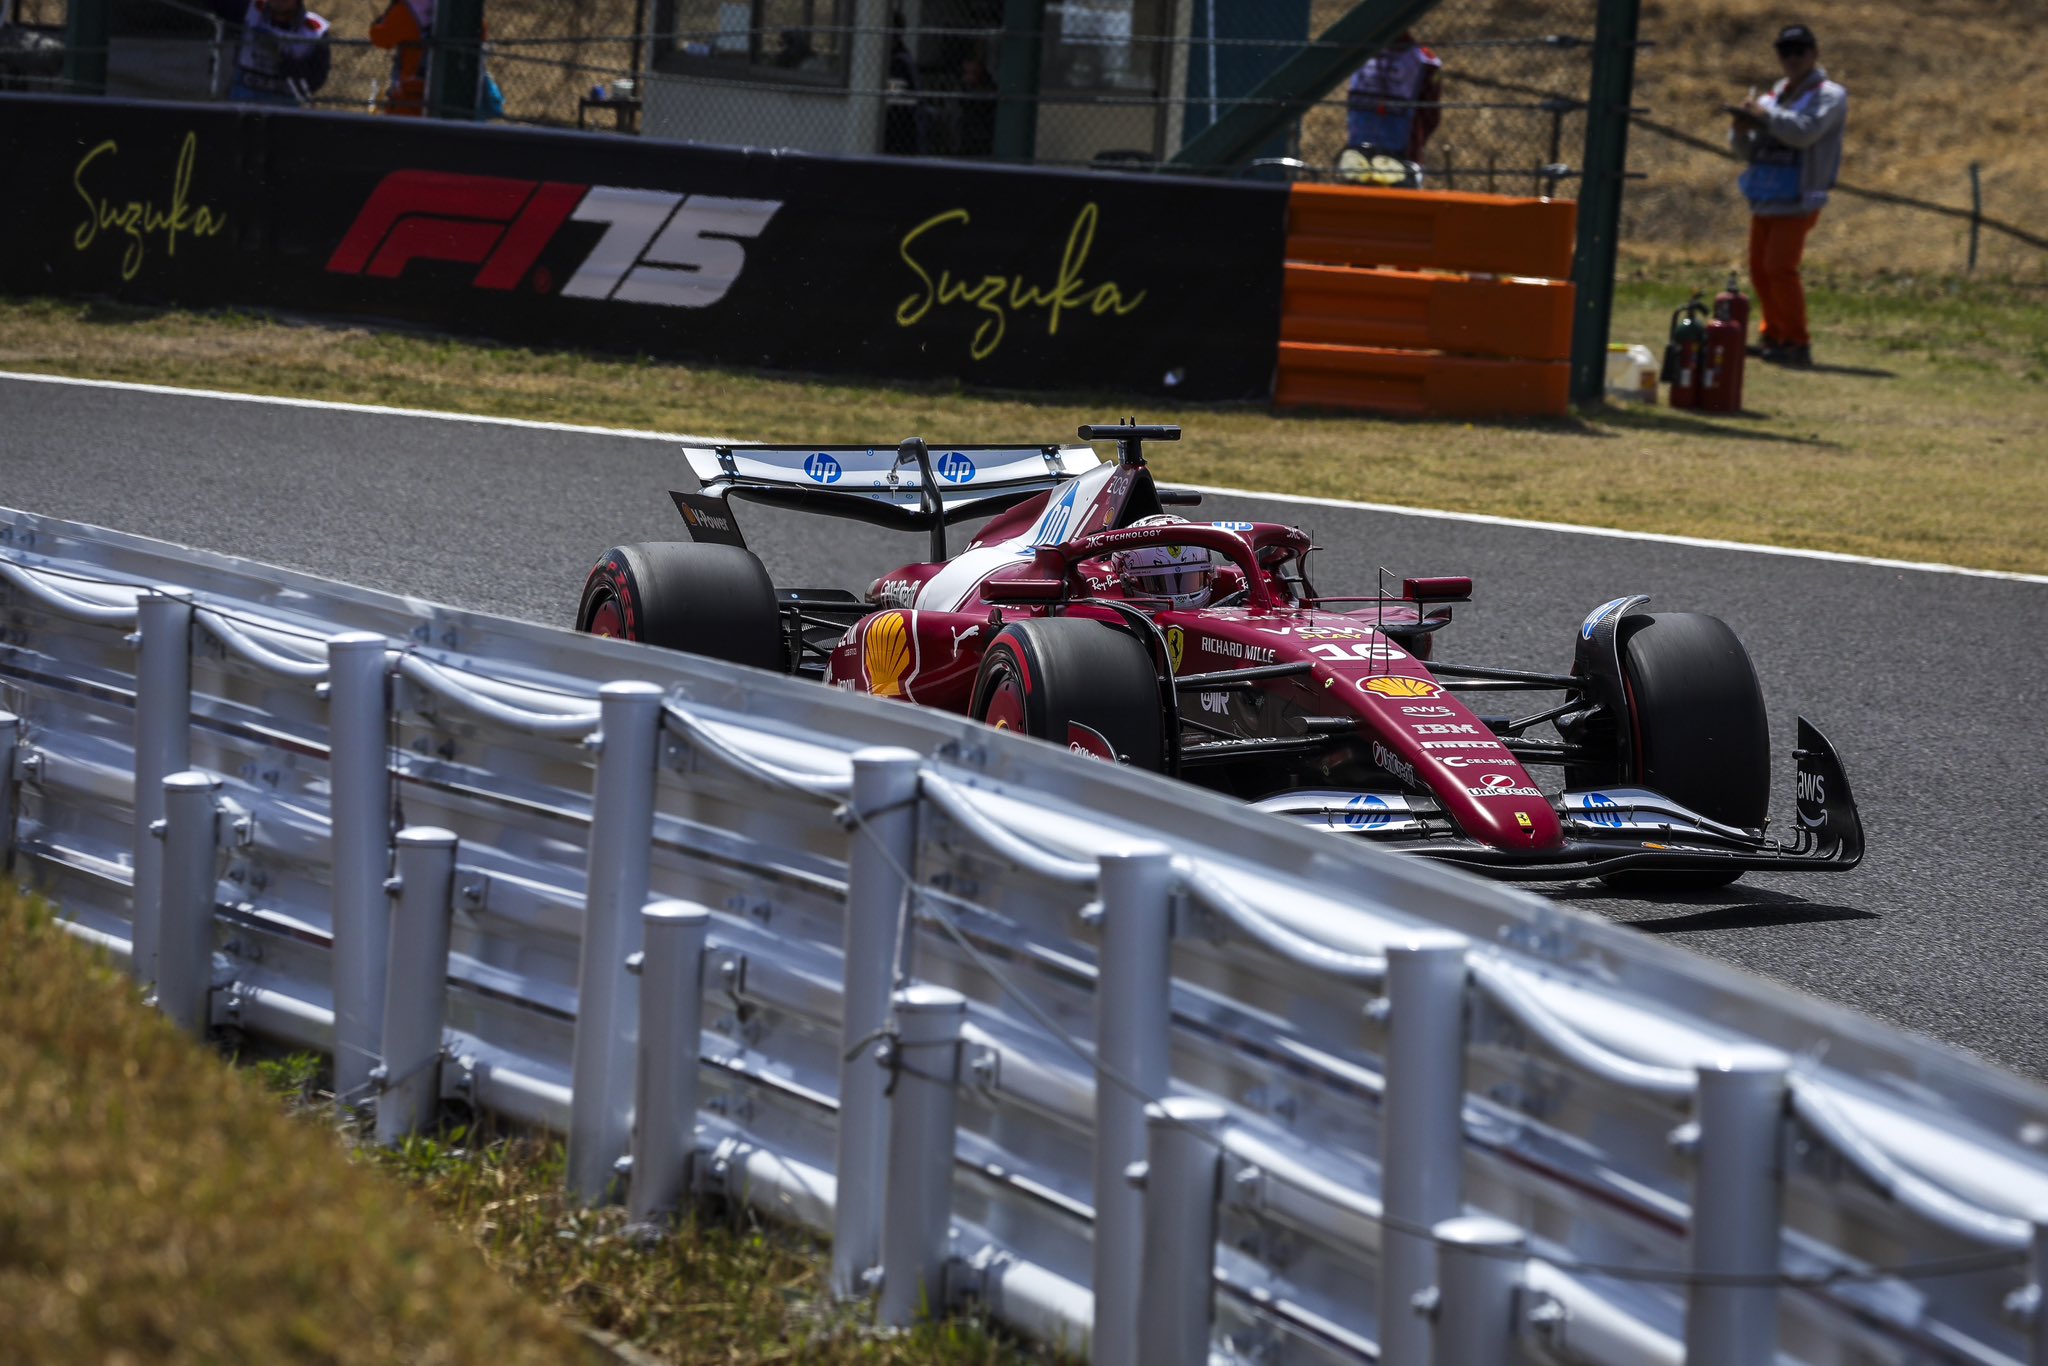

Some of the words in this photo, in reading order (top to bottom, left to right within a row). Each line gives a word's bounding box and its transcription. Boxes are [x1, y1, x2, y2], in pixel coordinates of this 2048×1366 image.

[75, 132, 225, 281] Suzuka
[559, 185, 784, 308] 75
[896, 202, 1146, 360] Suzuka
[806, 453, 839, 483] hp
[940, 452, 973, 483] hp
[1106, 529, 1162, 542] TECHNOLOGY
[1255, 626, 1374, 635] VGW
[1201, 636, 1242, 658] RICHARD
[1245, 645, 1276, 663] MILLE
[1307, 643, 1407, 661] 16
[1400, 706, 1451, 714] aws
[1412, 724, 1479, 735] IBM
[1467, 787, 1544, 798] UniCredit
[1797, 770, 1825, 804] aws
[1347, 795, 1390, 829] hp
[1584, 793, 1621, 827] hp
